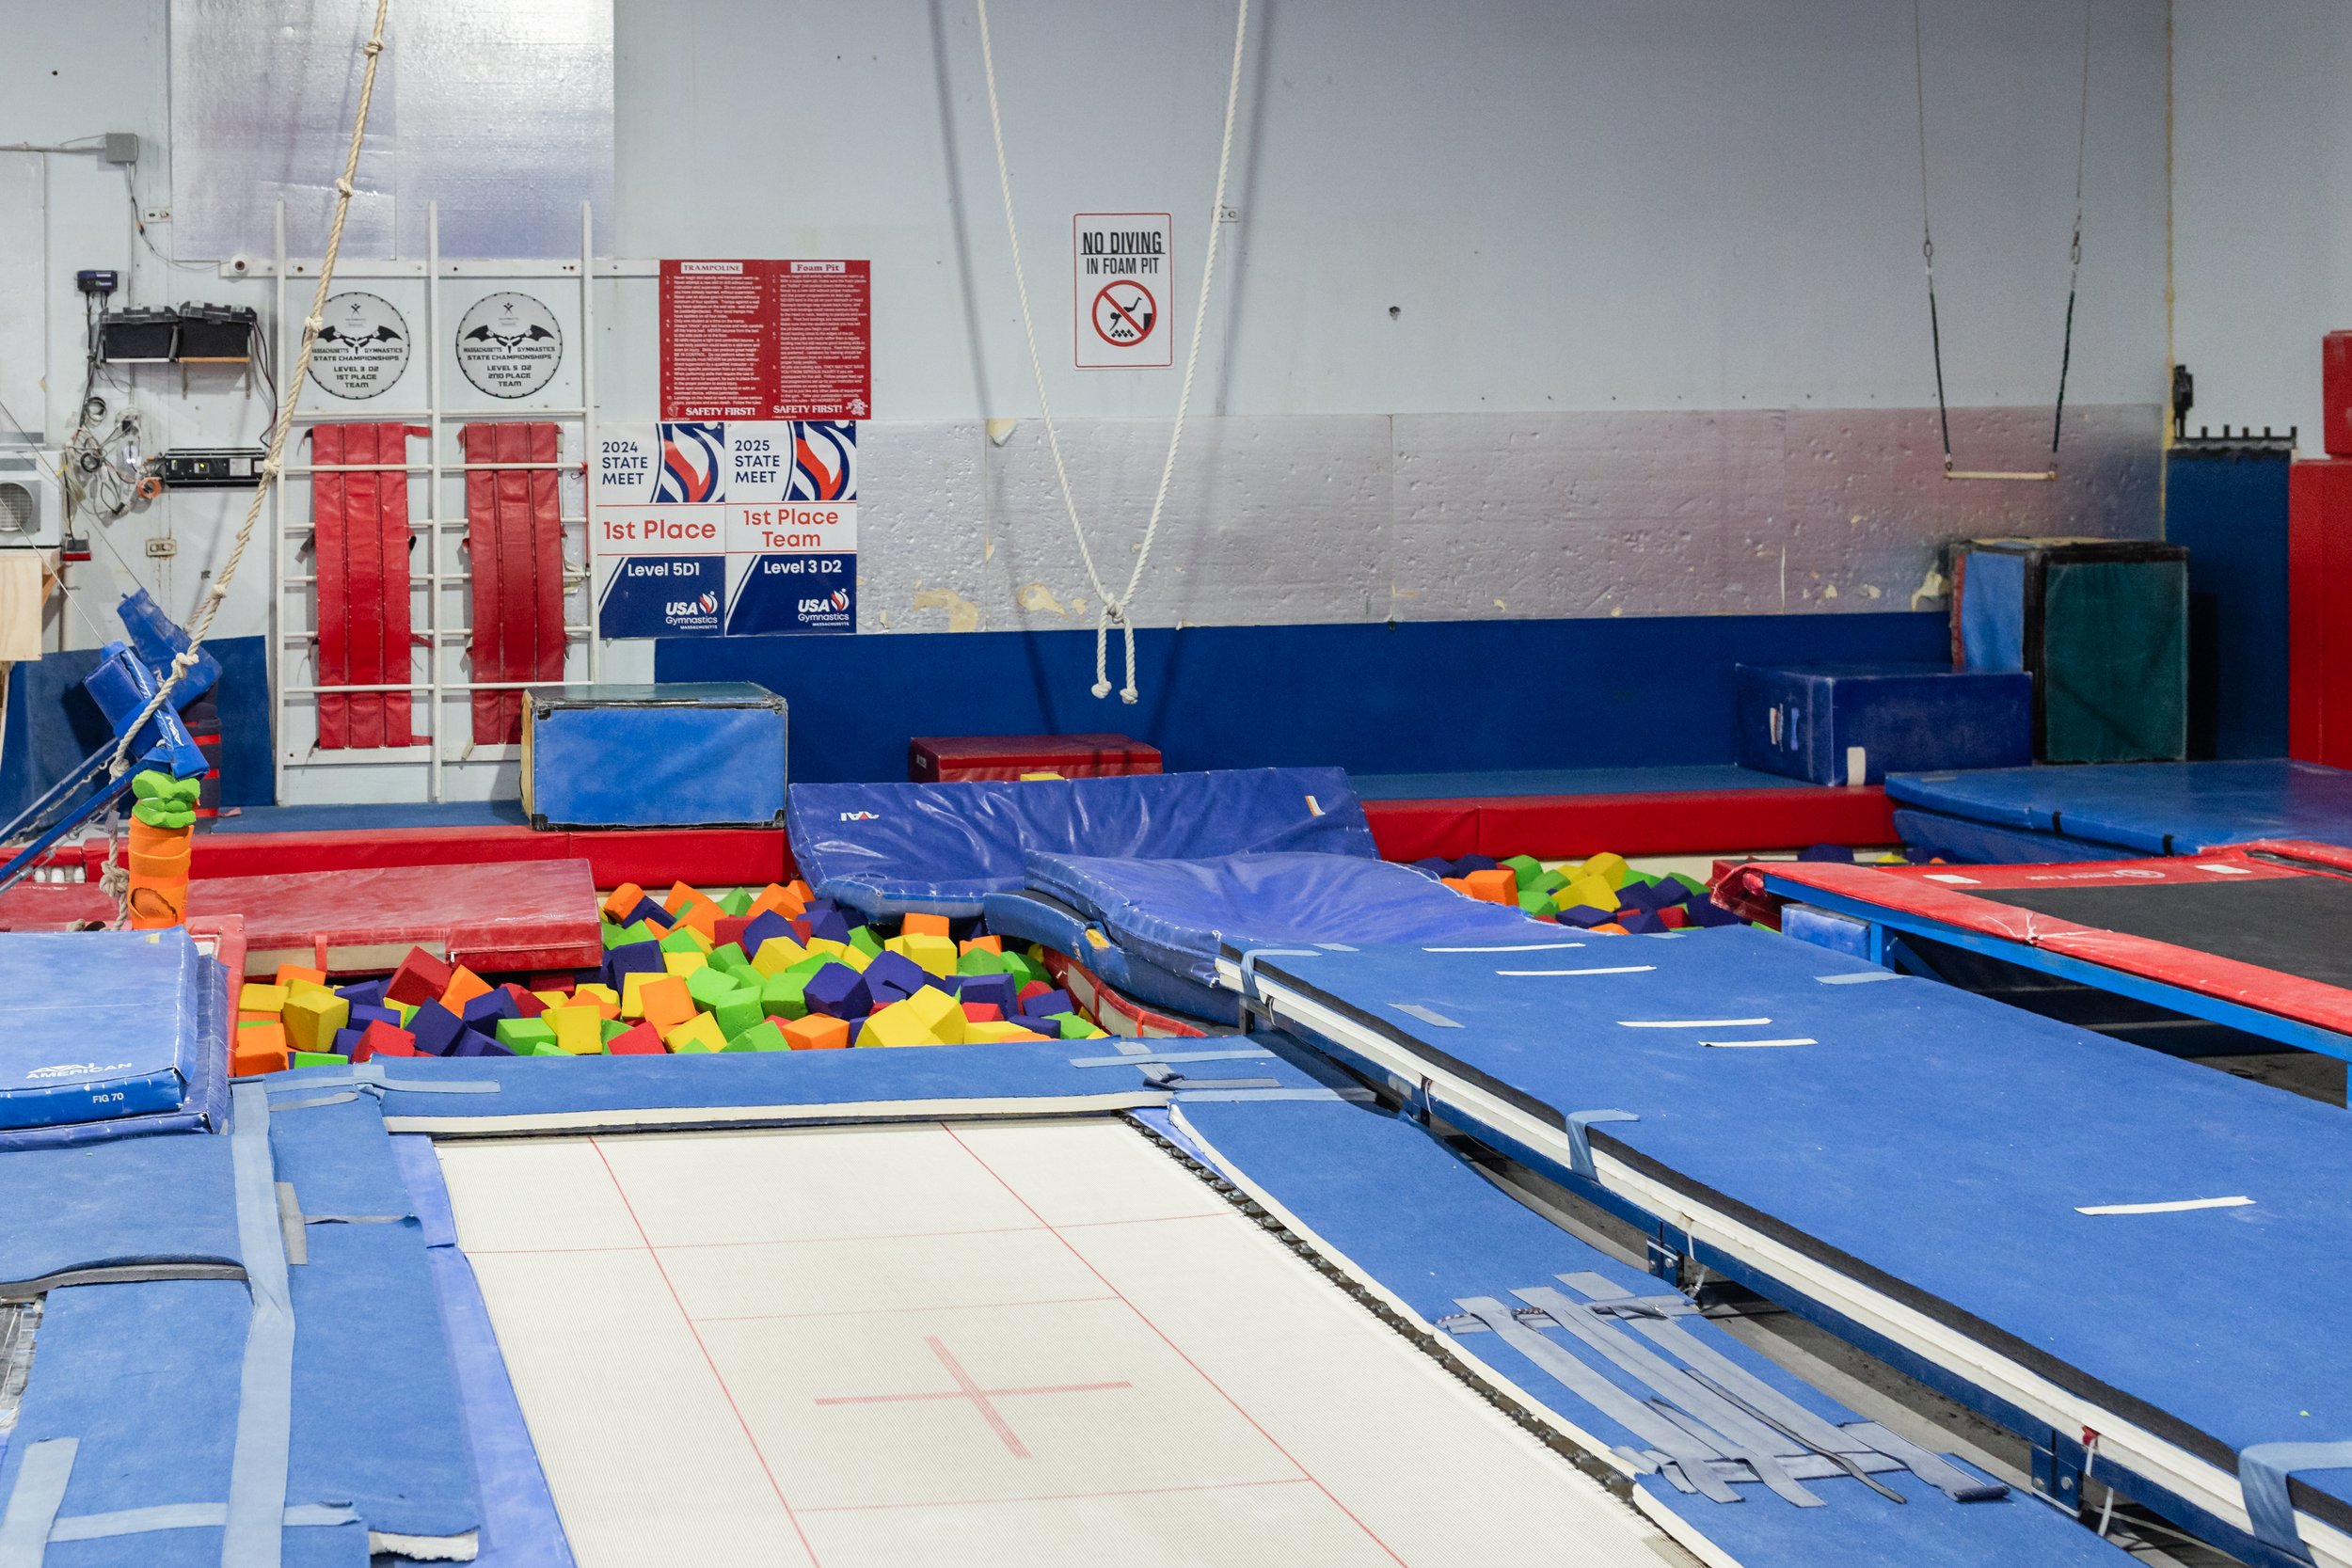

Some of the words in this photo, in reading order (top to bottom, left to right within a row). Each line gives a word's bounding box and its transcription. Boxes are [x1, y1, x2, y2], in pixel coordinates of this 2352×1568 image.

[1083, 231, 1104, 254] NO
[1110, 231, 1162, 254] DIVING
[1087, 258, 1099, 275] IN
[1104, 258, 1136, 275] FOAM
[1141, 258, 1159, 274] PIT
[686, 407, 723, 416] SAFETY
[724, 406, 756, 416] FIRST!
[773, 405, 808, 414] SAFETY
[812, 405, 843, 414] FIRST!
[602, 442, 638, 453] 2024
[735, 440, 770, 451] 2025
[602, 457, 648, 469] STATE
[735, 455, 780, 467] STATE
[602, 472, 644, 485] MEET
[735, 470, 777, 483] MEET
[743, 510, 771, 526] 1st
[778, 508, 839, 525] Place
[603, 521, 636, 540] 1st
[644, 519, 716, 540] Place
[762, 531, 821, 547] Team
[628, 562, 668, 577] Level
[673, 562, 700, 576] 5D1
[764, 561, 804, 575] Level
[808, 561, 818, 574] 3
[821, 560, 842, 574] D2
[665, 602, 698, 615] USA
[798, 598, 830, 612] USA
[665, 616, 718, 626] Gymnastics
[798, 613, 850, 623] Gymnastics
[26, 1062, 132, 1079] AMERICAN
[92, 1094, 109, 1104] FIG
[111, 1092, 124, 1101] 70
